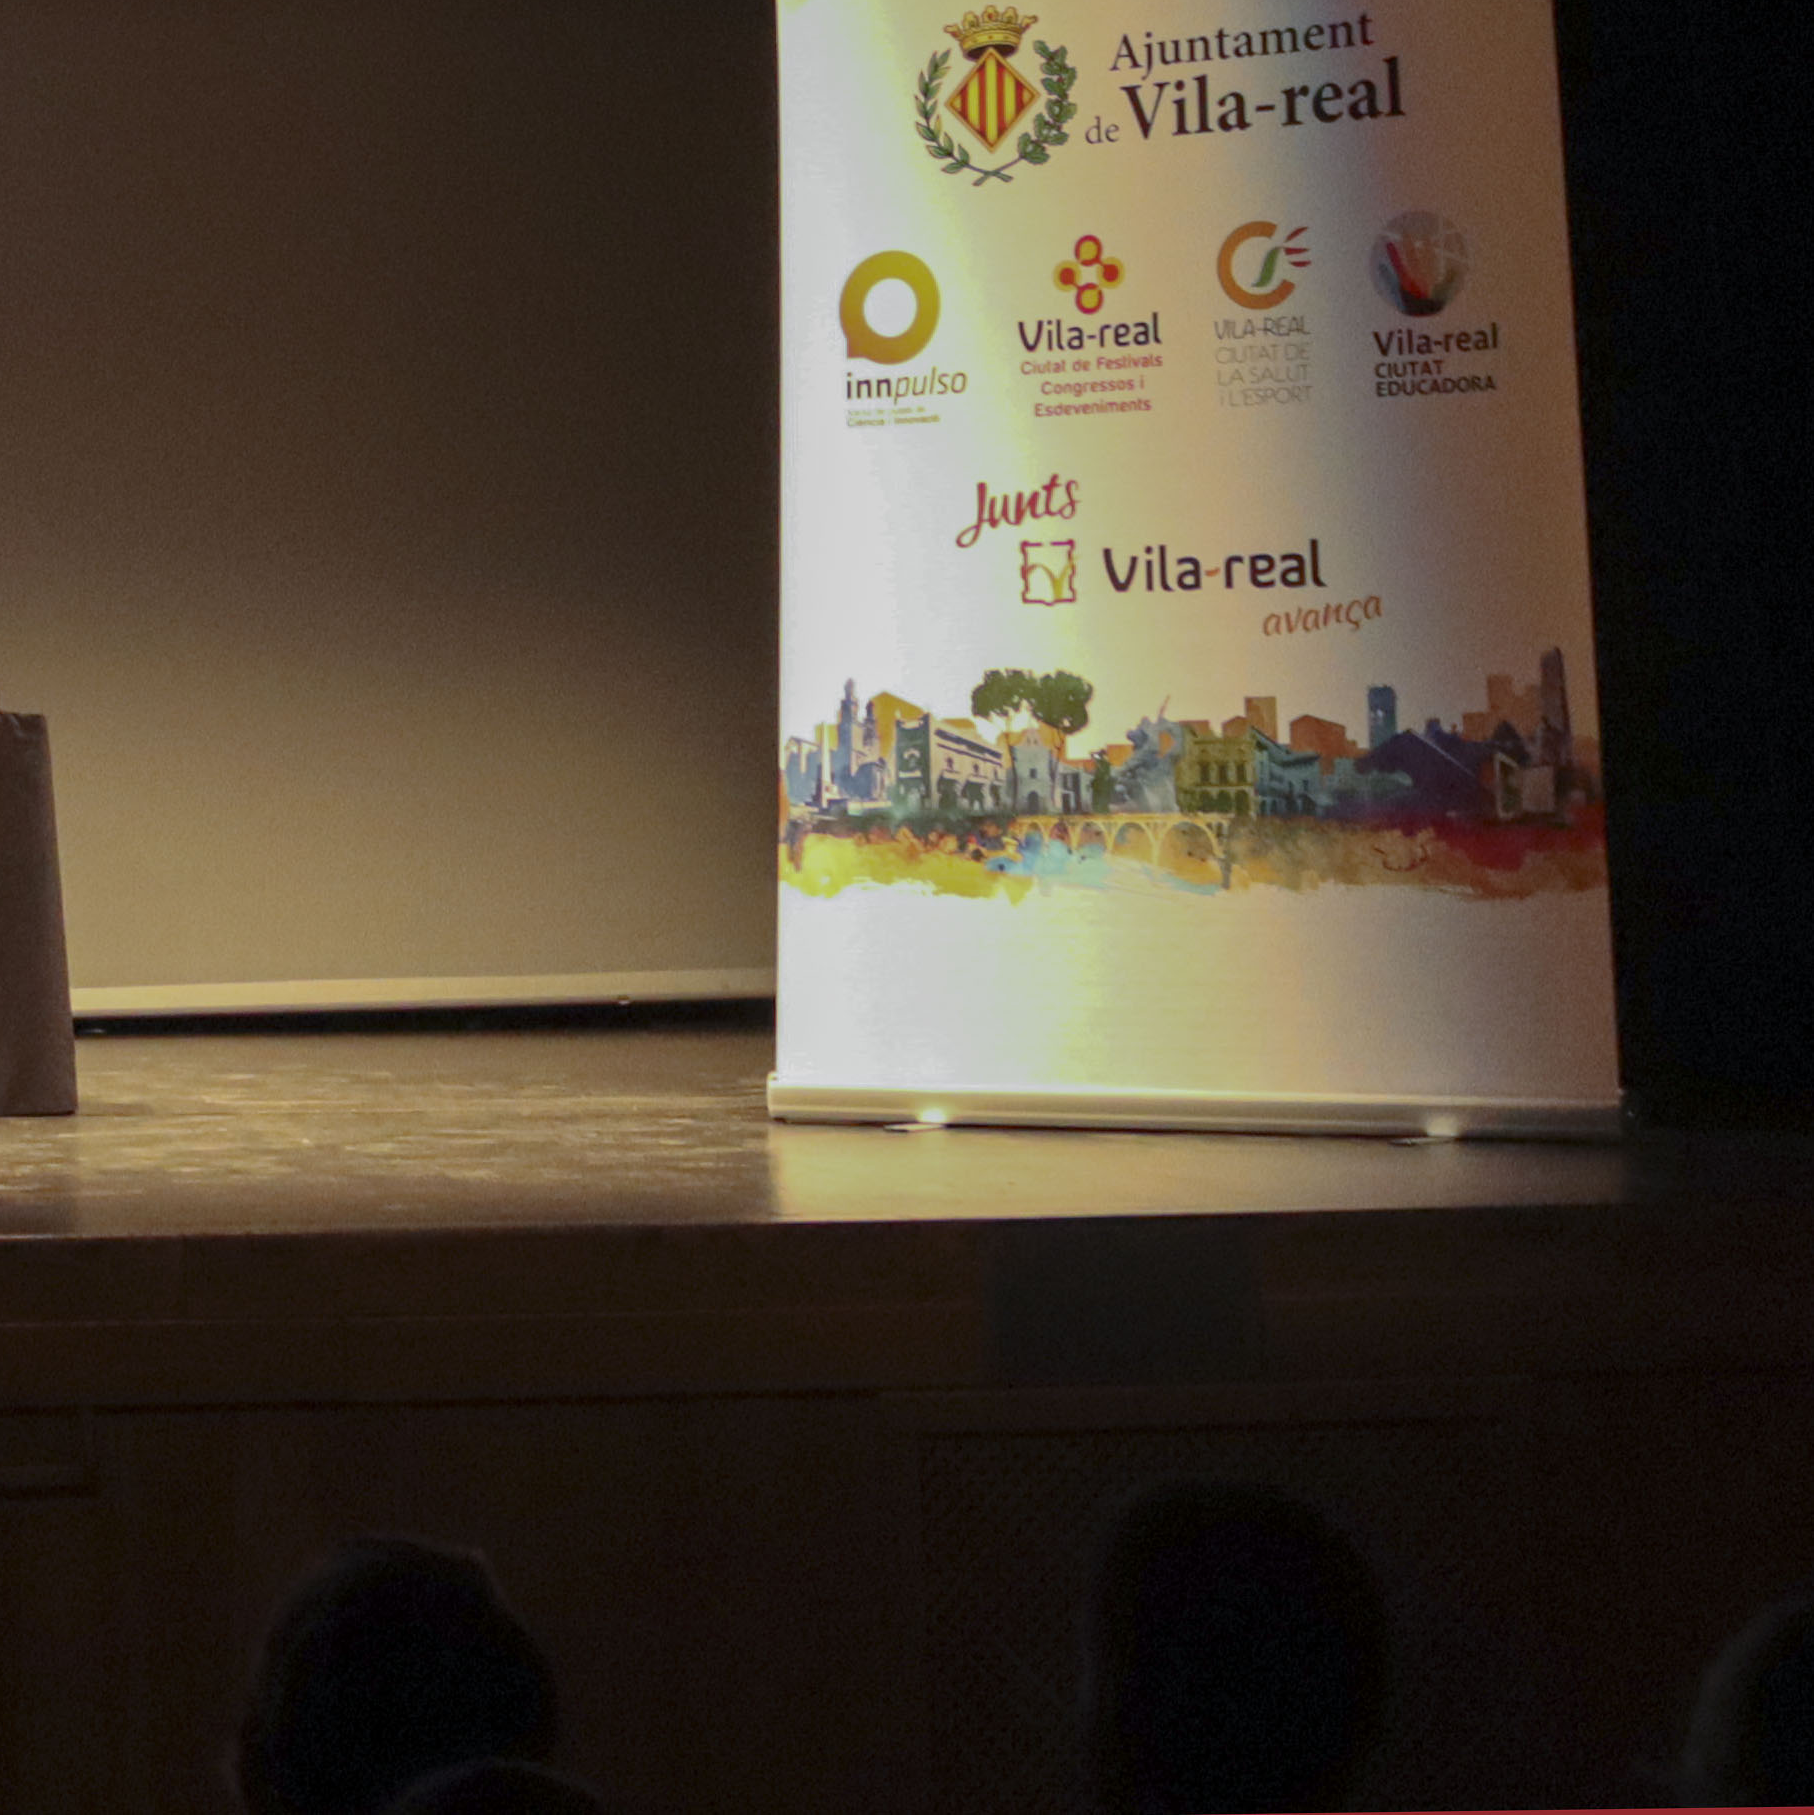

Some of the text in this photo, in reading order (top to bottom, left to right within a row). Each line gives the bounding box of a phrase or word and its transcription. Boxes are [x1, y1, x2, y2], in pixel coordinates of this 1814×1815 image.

[1108, 12, 1374, 81] Ajuntament
[1084, 55, 1406, 144] de Vila-real
[1018, 312, 1163, 352] Vila-real
[1213, 315, 1312, 339] VILA-REAL
[1372, 322, 1500, 357] Vila-real
[1020, 352, 1164, 376] Ciutat de Festivals
[1215, 341, 1312, 364] CIUTAT DE
[1216, 364, 1310, 386] LA SALUT
[1374, 360, 1444, 379] CIUTAT
[846, 366, 969, 405] innpulso
[1040, 378, 1135, 397] Congressos
[1375, 375, 1498, 398] EDUCADORA
[1034, 397, 1152, 417] Esdeveniments
[956, 473, 1081, 547] Junts
[1102, 538, 1328, 592] Vila-real
[1263, 595, 1383, 637] avança
